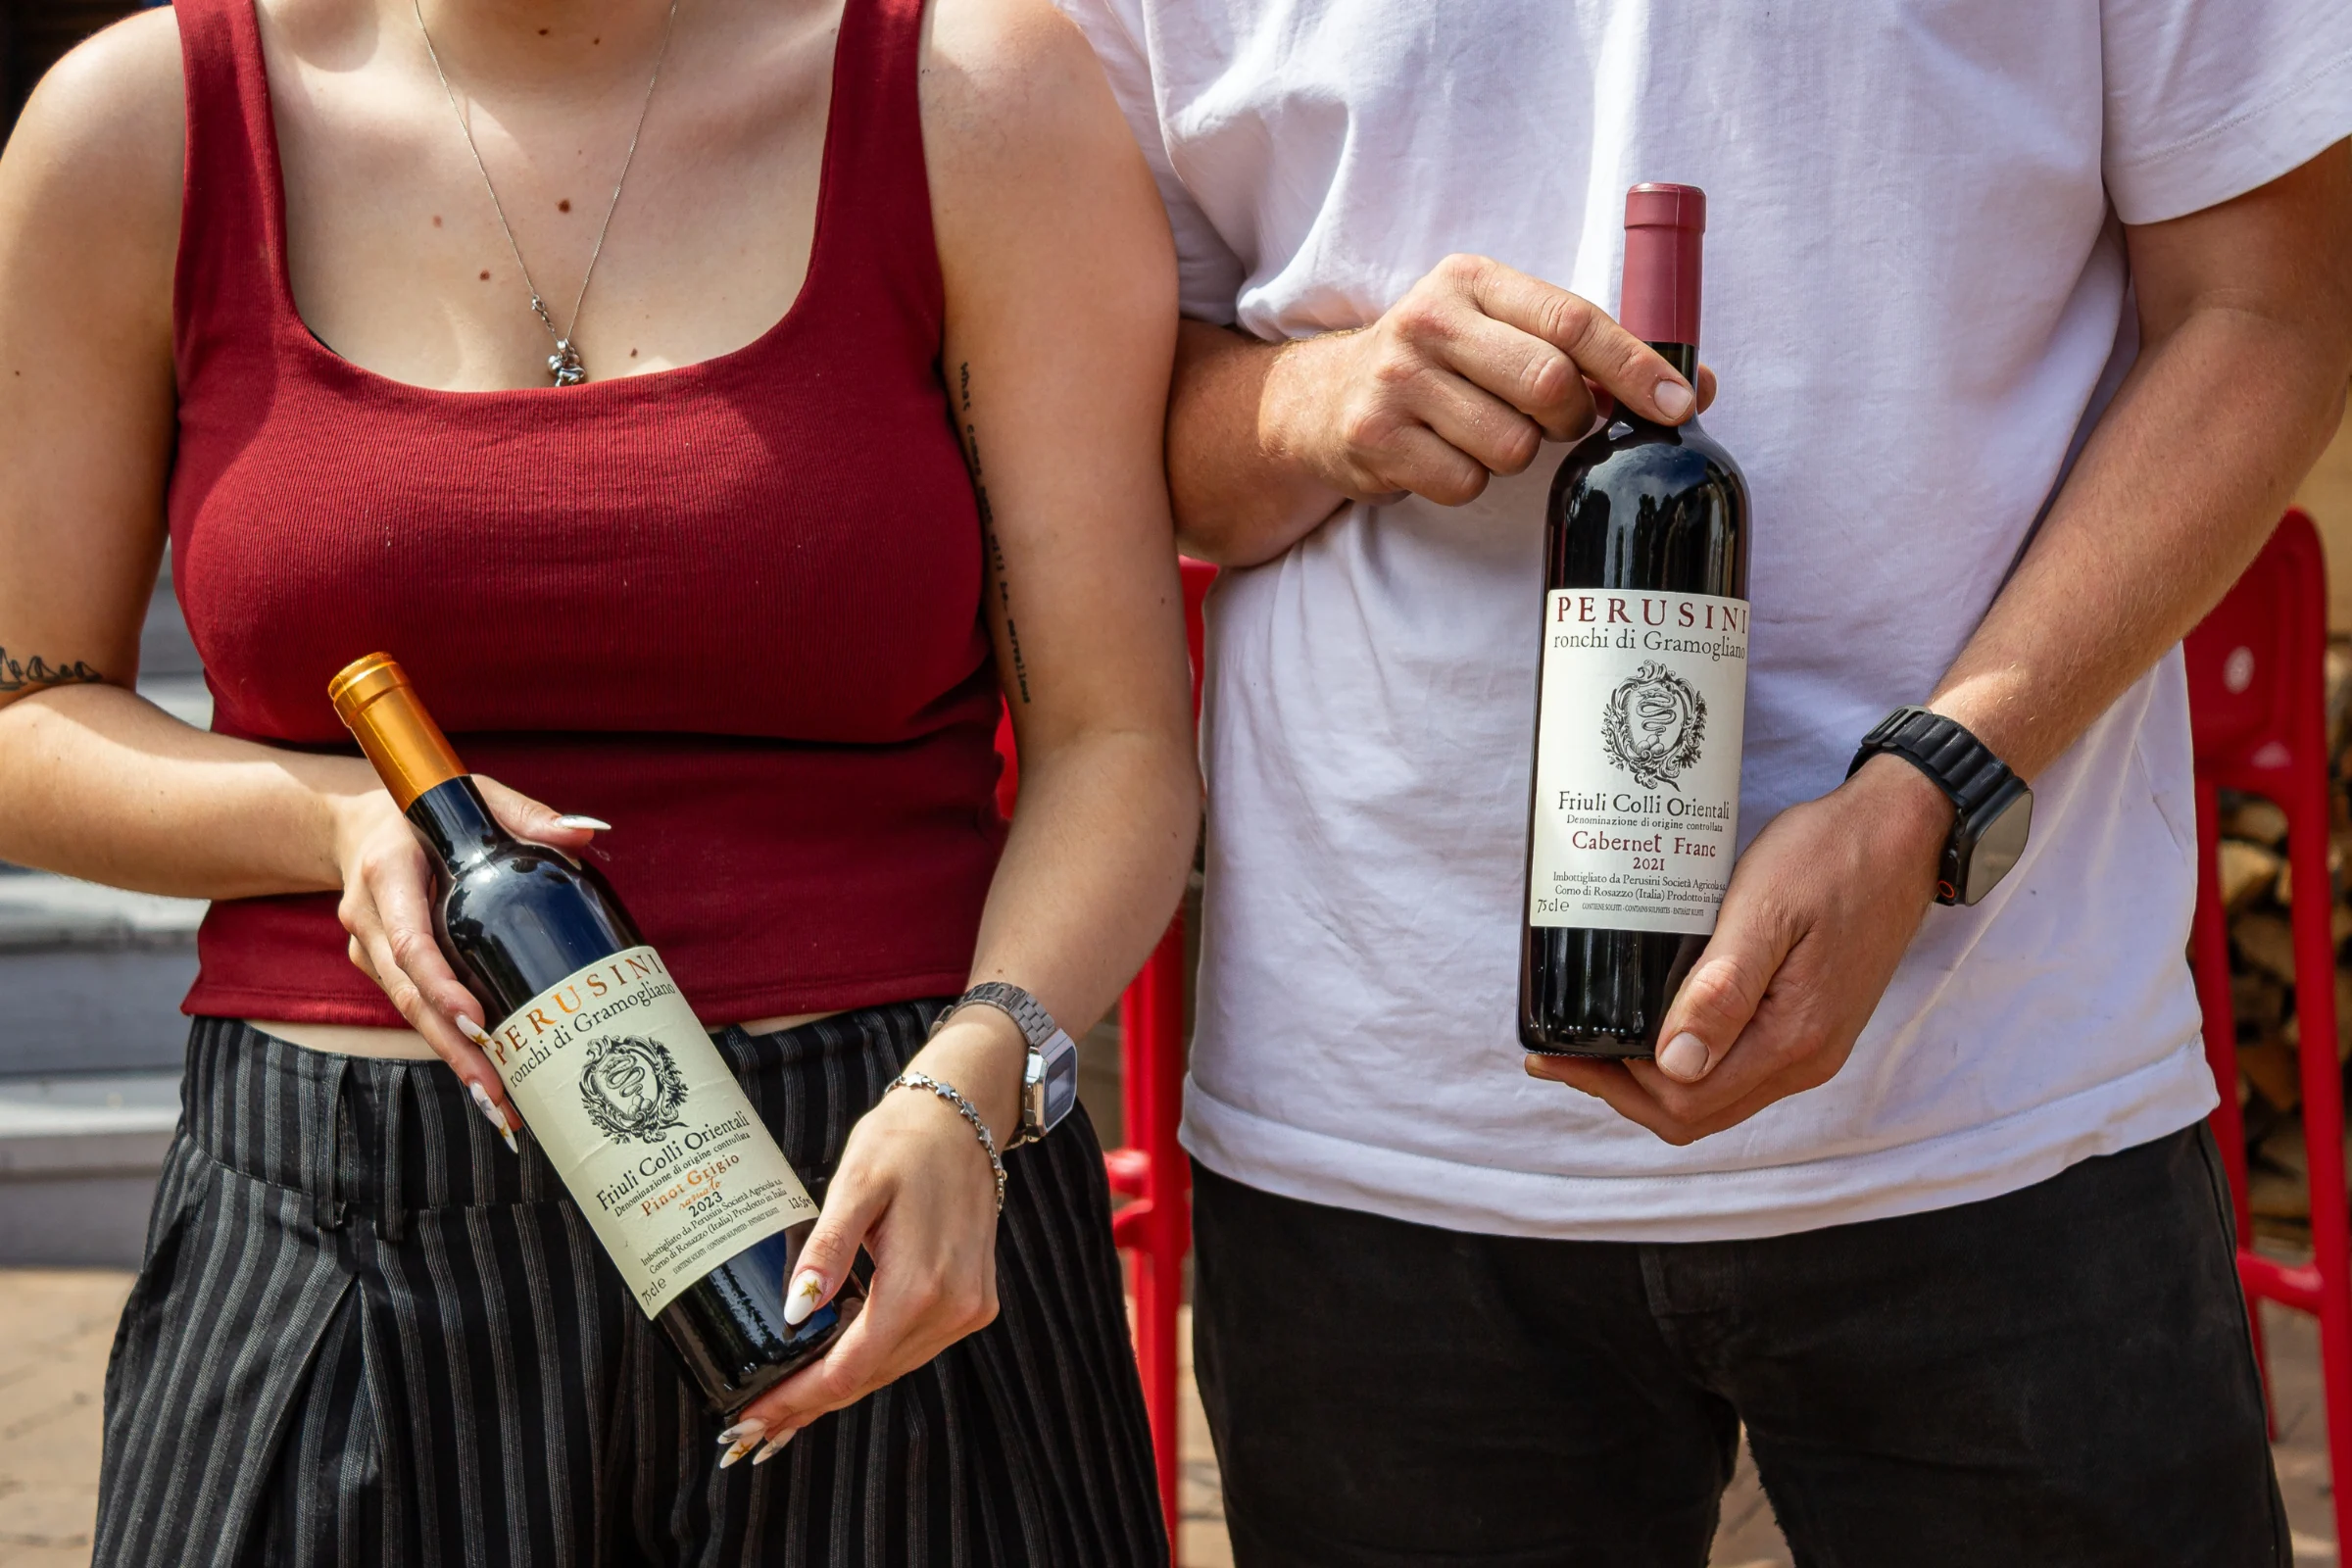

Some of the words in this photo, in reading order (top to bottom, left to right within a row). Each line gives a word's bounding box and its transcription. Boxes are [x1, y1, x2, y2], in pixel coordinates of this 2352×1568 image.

[1557, 596, 1747, 634] PERUSINI
[1553, 627, 1609, 649] ronchi
[1615, 628, 1637, 650] di
[1643, 630, 1746, 662] Gramogliano
[1558, 790, 1607, 812] Friuli
[1613, 793, 1661, 814] Colli
[1667, 797, 1730, 820] Orientali
[1566, 814, 1638, 827] Denominazione
[1641, 816, 1650, 827] di
[1651, 818, 1684, 831] origine
[1686, 820, 1724, 833] controllata
[1572, 830, 1663, 854] Cabernet
[1673, 836, 1717, 858] Franc
[1553, 871, 1608, 886] Imbottigliato
[1608, 872, 1621, 884] da
[1623, 874, 1661, 886] Perusini
[1662, 876, 1691, 888] Società
[1692, 878, 1720, 892] Agricola
[1633, 856, 1665, 872] 2021
[1554, 884, 1582, 896] Corno
[1582, 885, 1592, 896] di
[1593, 886, 1634, 899] Rosazzo
[1635, 887, 1665, 902] (Italia)
[1666, 890, 1703, 903] Prodotto
[1703, 892, 1711, 903] in
[1711, 893, 1724, 905] Itali
[493, 954, 663, 1066] PERUSINI
[510, 1039, 553, 1088] ronchi
[554, 1024, 574, 1050] di
[573, 980, 676, 1033] Gramogliano
[596, 1169, 639, 1211] Friuli
[639, 1140, 683, 1177] Colli
[684, 1109, 750, 1151] Orientali
[614, 1173, 671, 1217] Denominazione
[673, 1165, 683, 1175] di
[683, 1150, 712, 1169] origine
[713, 1131, 751, 1152] controllata
[641, 1183, 686, 1216] Pinot
[687, 1154, 740, 1185] Grigio
[640, 1237, 682, 1266] Imbottigliato
[682, 1226, 693, 1237] da
[690, 1204, 723, 1230] Perusini
[721, 1191, 750, 1210] Società
[748, 1179, 775, 1198] Agricola
[688, 1191, 723, 1218] 2023
[649, 1256, 670, 1275] Corno
[669, 1248, 678, 1259] di
[675, 1230, 709, 1254] Rosazzo
[708, 1213, 734, 1235] (Italia)
[732, 1198, 766, 1219] Prodotto
[766, 1194, 774, 1202] in
[771, 1187, 788, 1200] Italia
